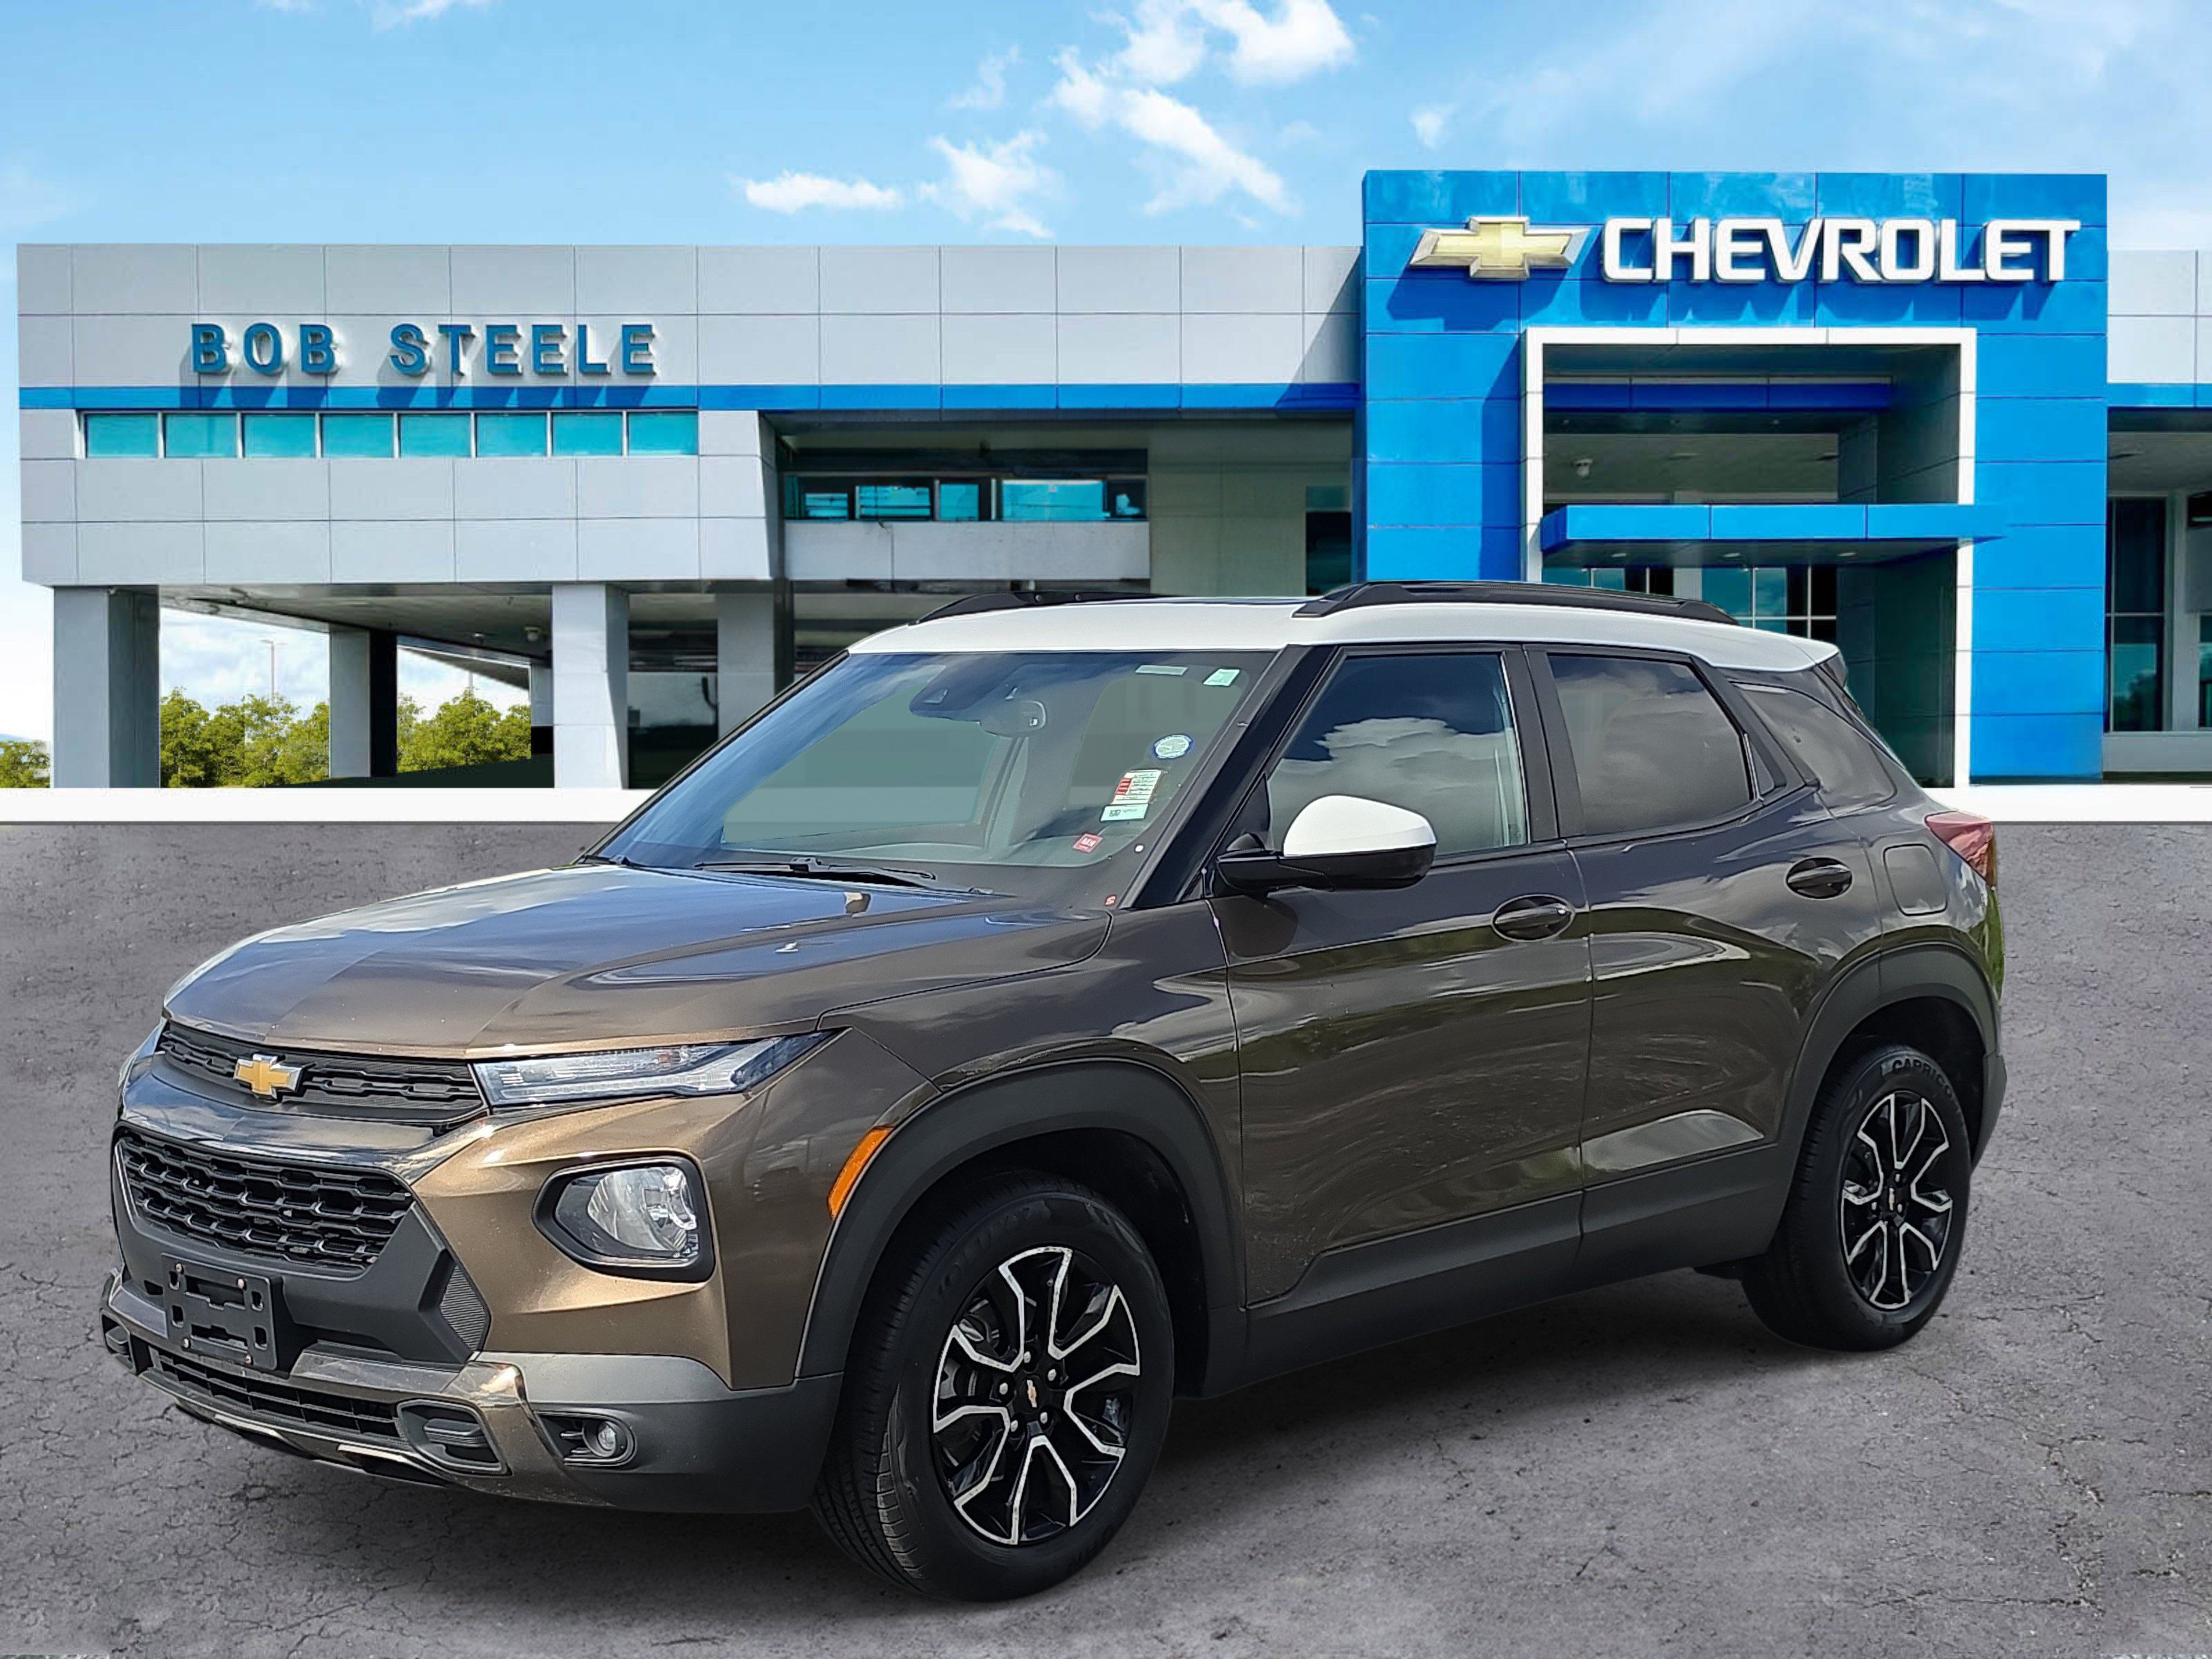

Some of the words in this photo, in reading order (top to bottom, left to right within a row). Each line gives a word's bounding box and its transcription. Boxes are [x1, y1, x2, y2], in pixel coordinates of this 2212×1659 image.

[1602, 217, 2081, 283] CHEVROLET
[191, 323, 339, 375] BOB
[389, 323, 657, 377] STEELE
